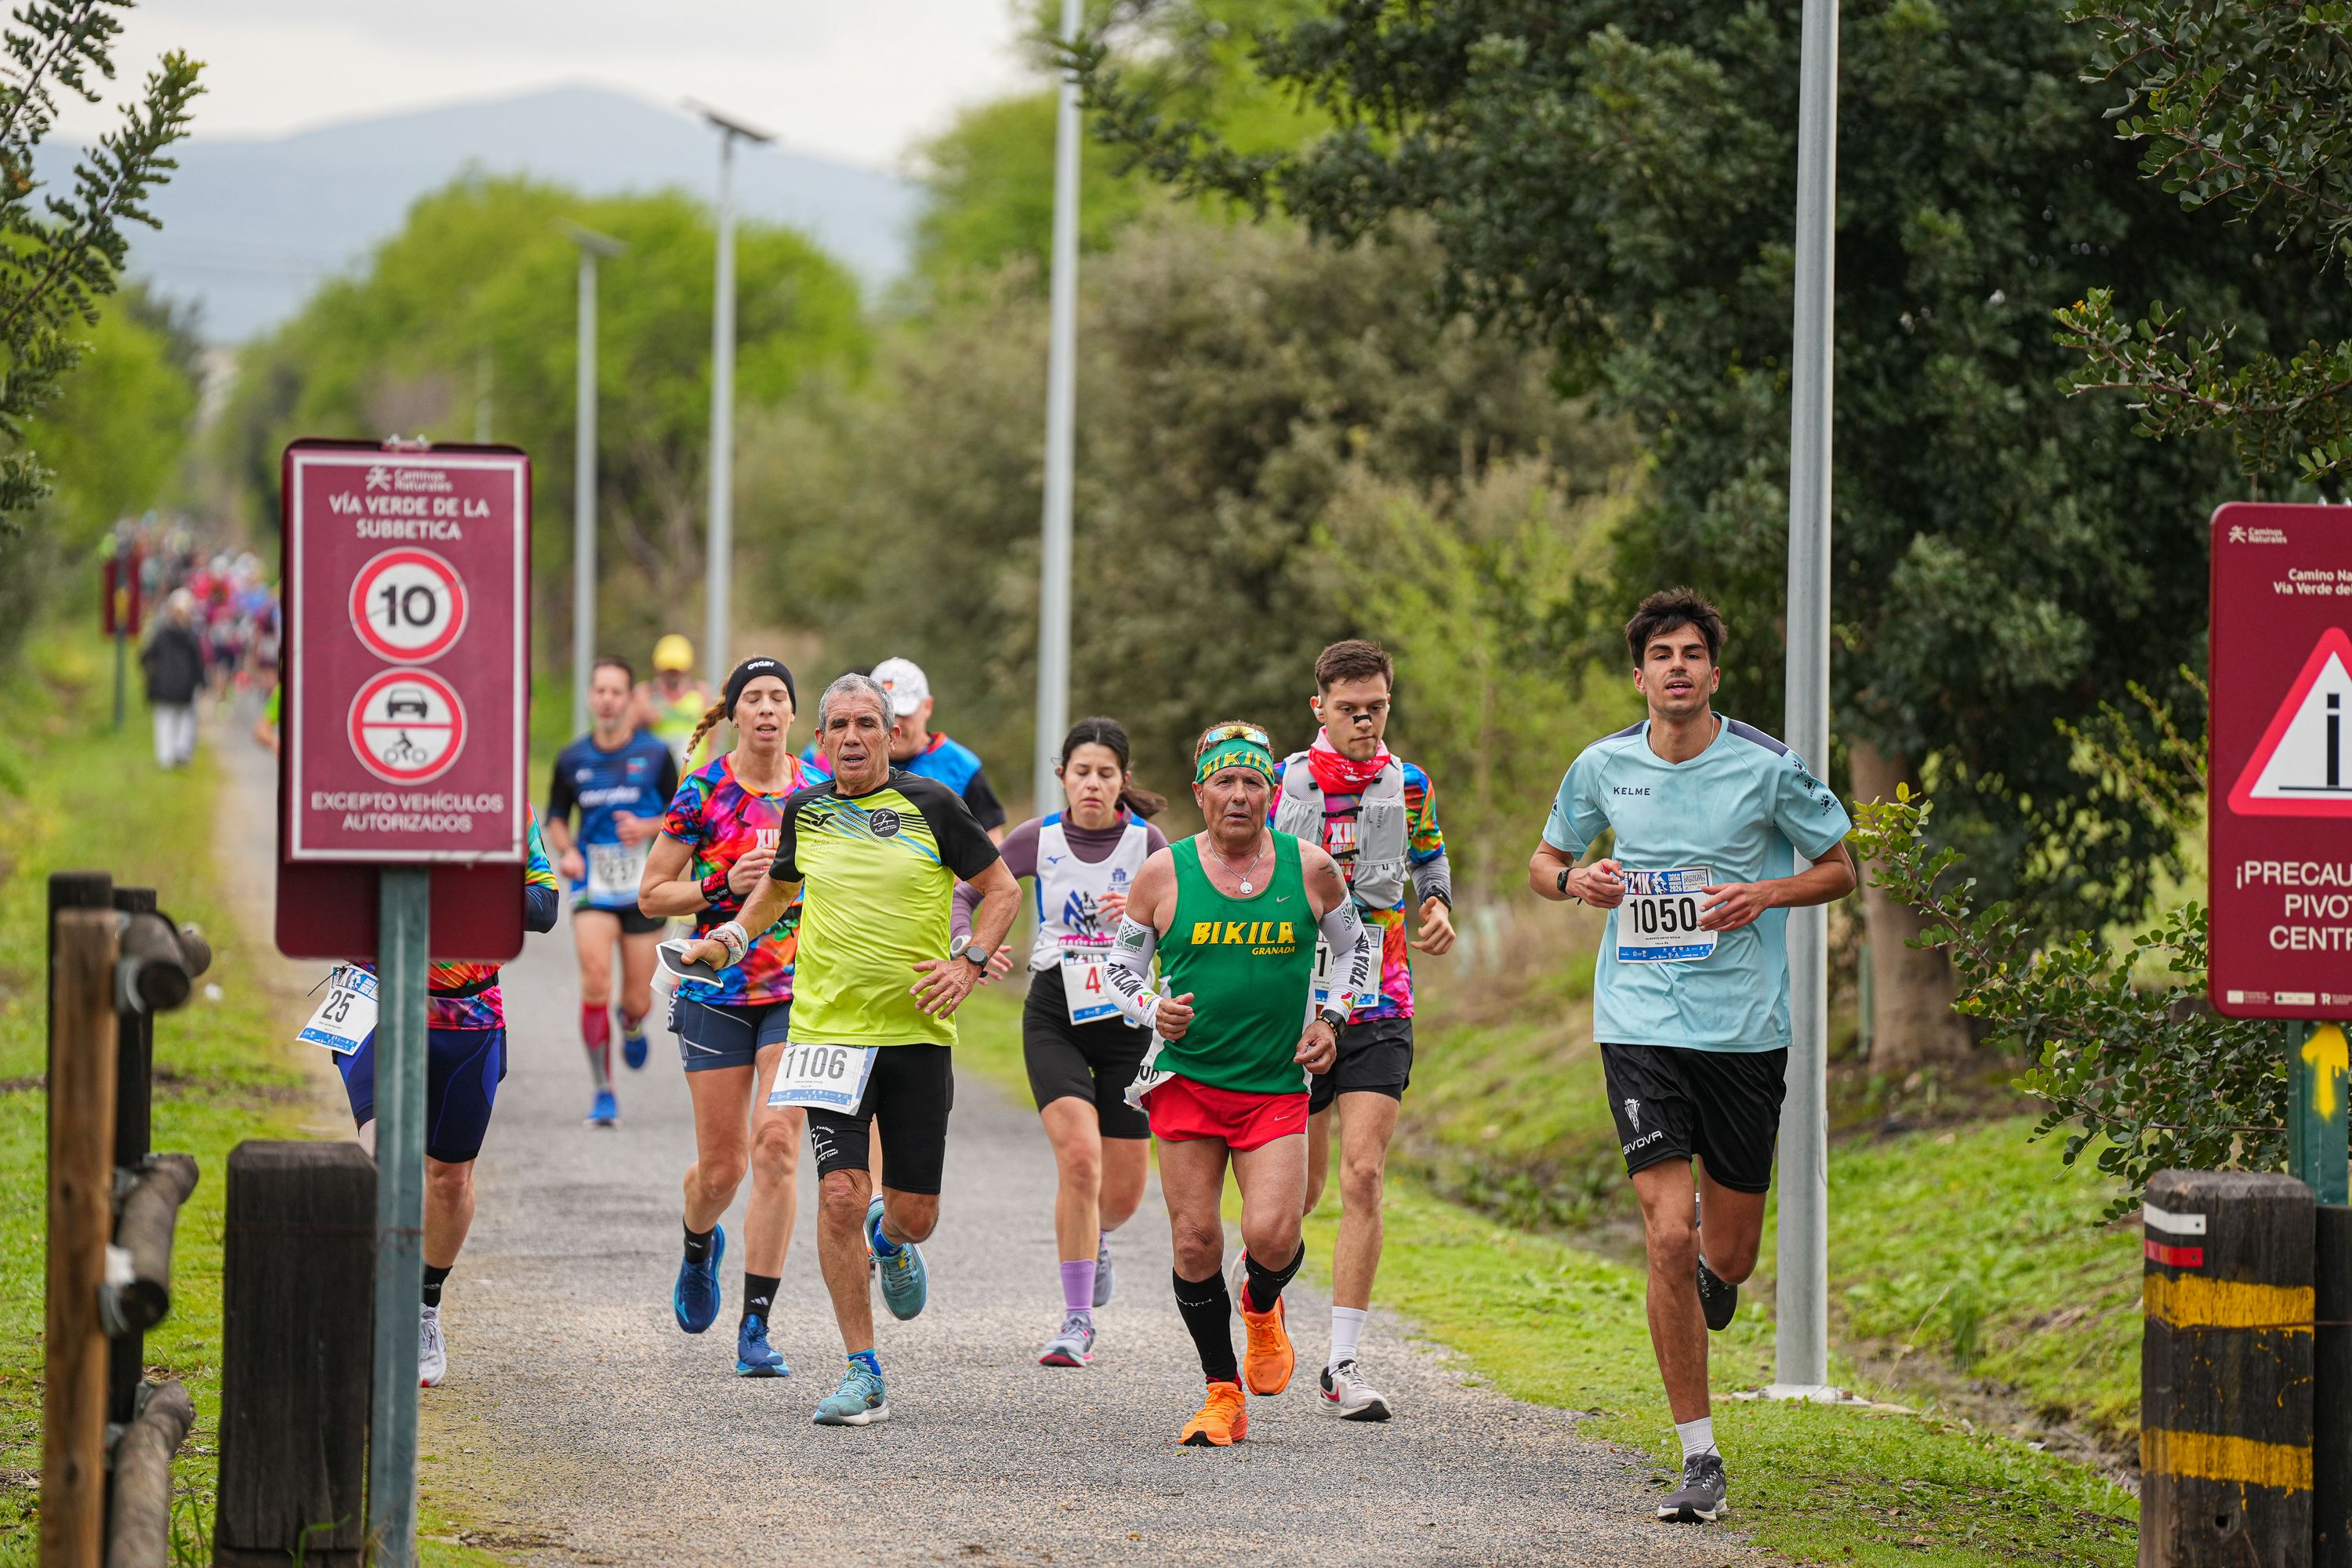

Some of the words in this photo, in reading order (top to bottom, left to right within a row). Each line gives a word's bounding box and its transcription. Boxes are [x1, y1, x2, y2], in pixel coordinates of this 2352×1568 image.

[394, 468, 446, 481] Caminos
[394, 480, 453, 492] Naturales
[329, 491, 362, 514] VÍA
[365, 495, 427, 516] VERDE
[434, 498, 459, 517] DE
[464, 498, 490, 518] LA
[357, 518, 463, 539] SUBBETICA
[2248, 535, 2288, 544] Naturales
[2288, 568, 2335, 582] Camino
[2296, 583, 2332, 596] Verde
[379, 585, 436, 627] 10
[311, 791, 397, 811] EXCEPTO
[399, 789, 505, 813] VEHÍCULOS
[1613, 786, 1651, 796] KELME
[1822, 799, 1838, 817] KELME
[343, 814, 473, 833] AUTORIZADOS
[1630, 897, 1697, 934] 1050
[2285, 894, 2352, 919] PIVO
[1191, 921, 1296, 945] BIKILA
[1252, 946, 1296, 955] GRANADA
[321, 989, 356, 1022] 25
[786, 1047, 848, 1079] 1106
[1623, 1130, 1663, 1156] GIVOVA
